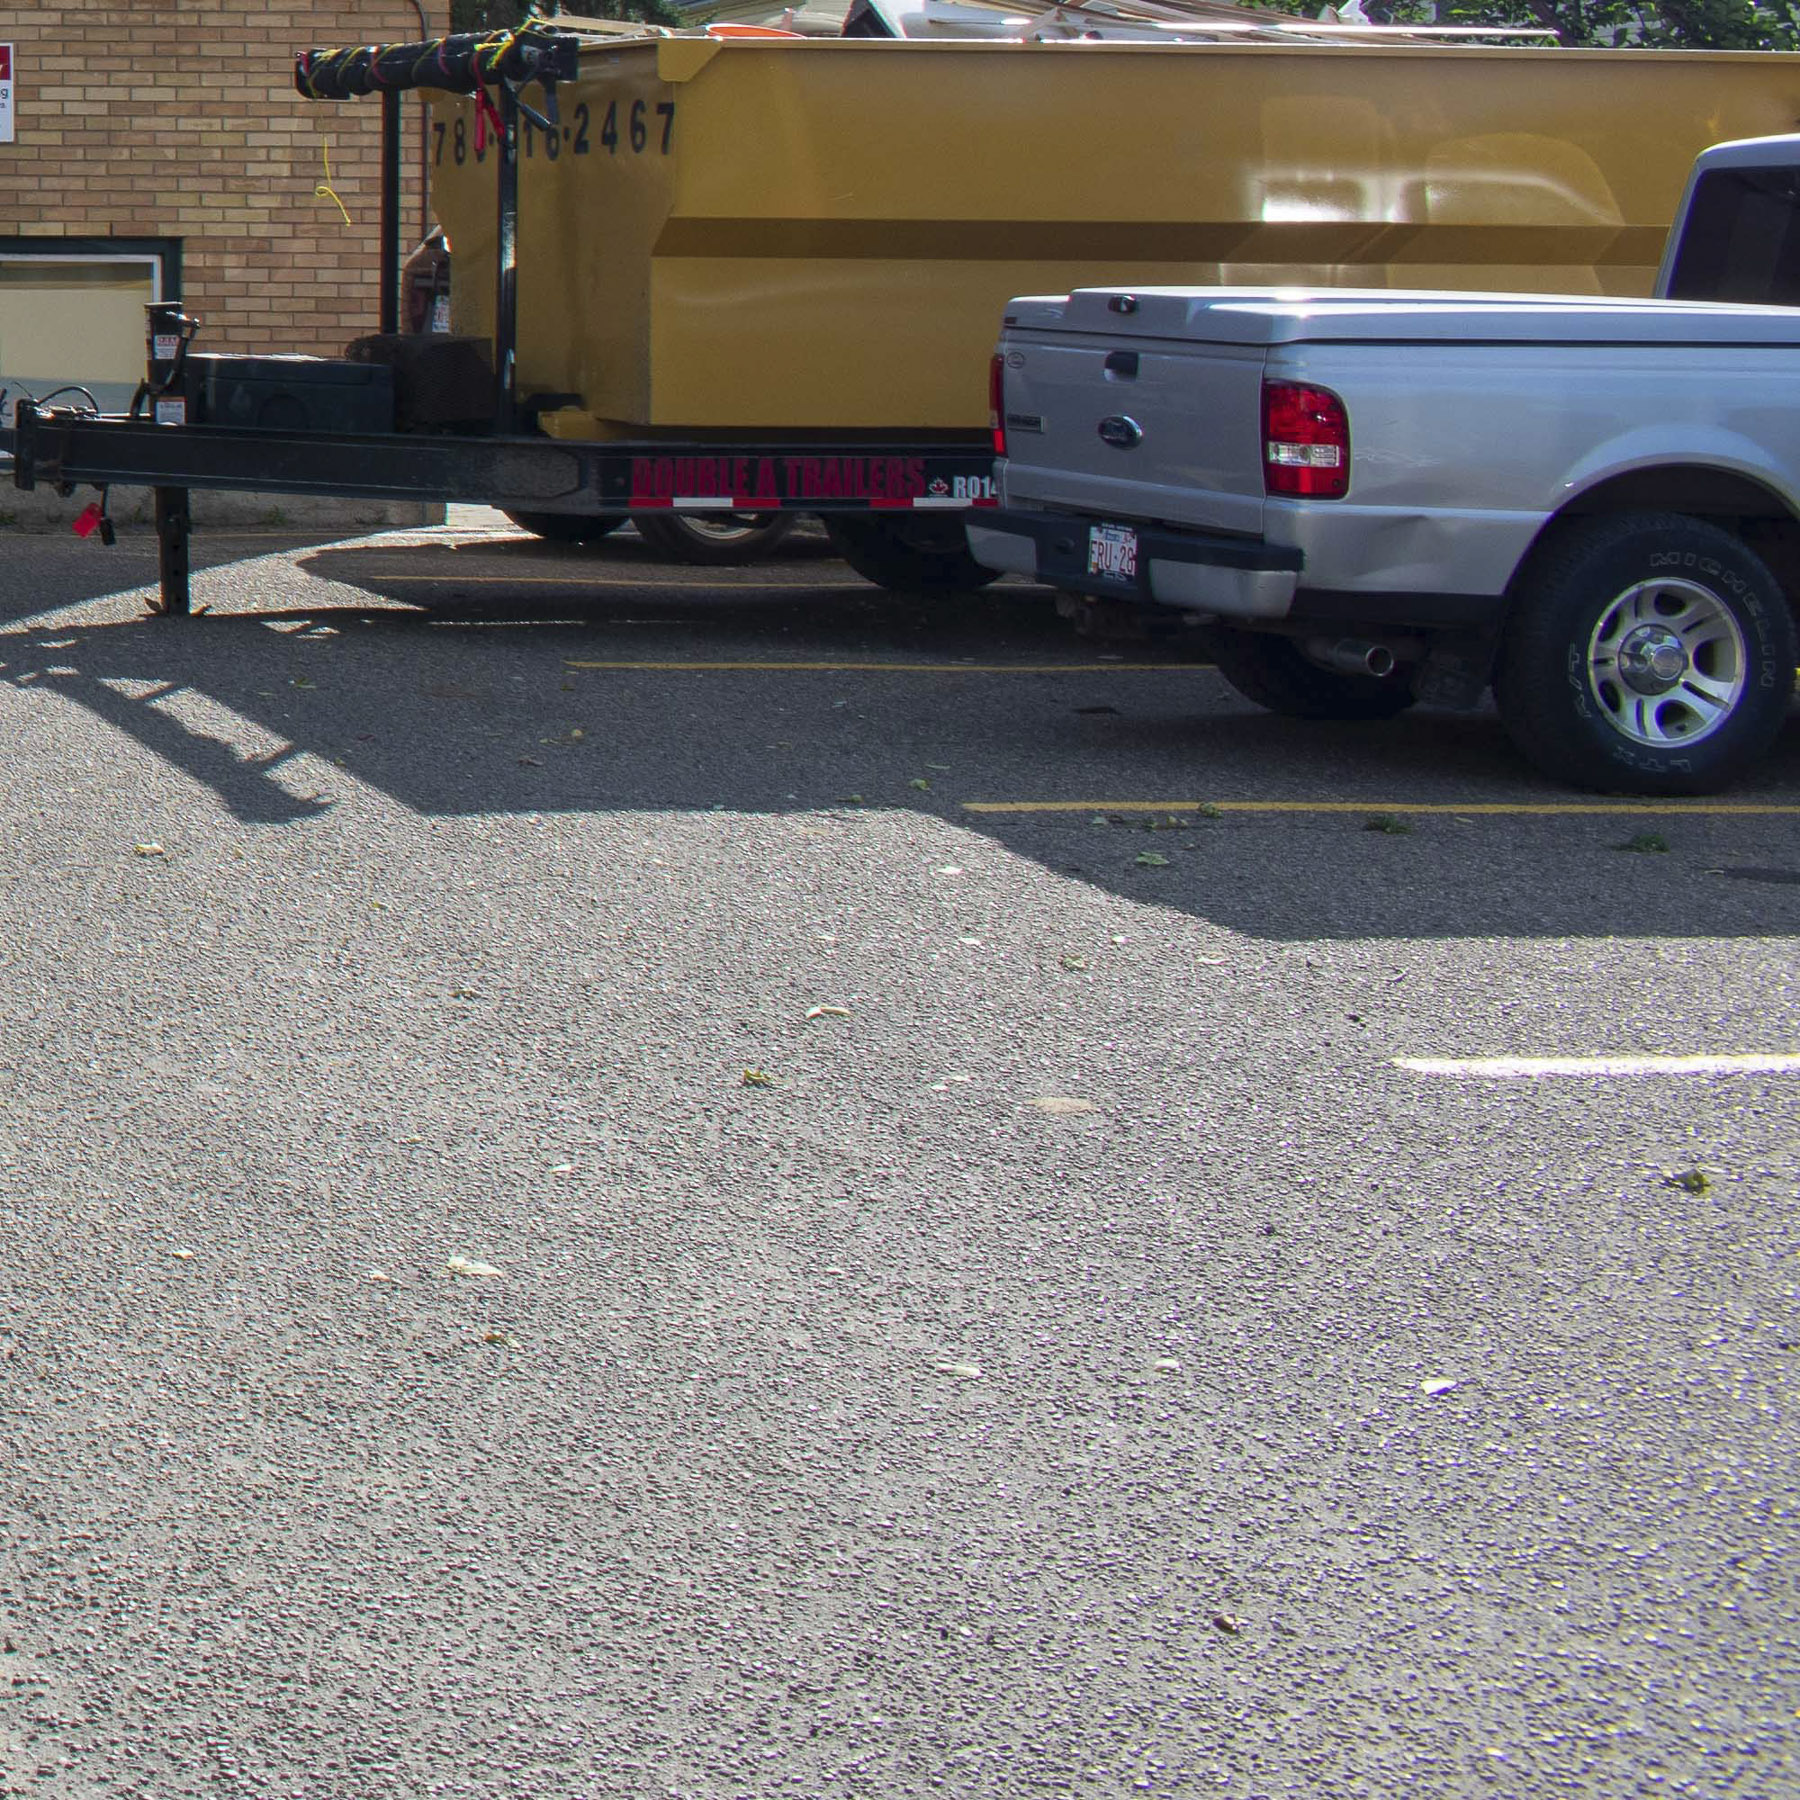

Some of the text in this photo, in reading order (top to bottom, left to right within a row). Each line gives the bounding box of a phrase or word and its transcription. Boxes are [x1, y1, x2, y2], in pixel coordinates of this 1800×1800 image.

[433, 99, 675, 167] 78-16-2467
[632, 456, 926, 498] DOUBLE A TRAILERS
[1648, 551, 1778, 689] MICHELIN
